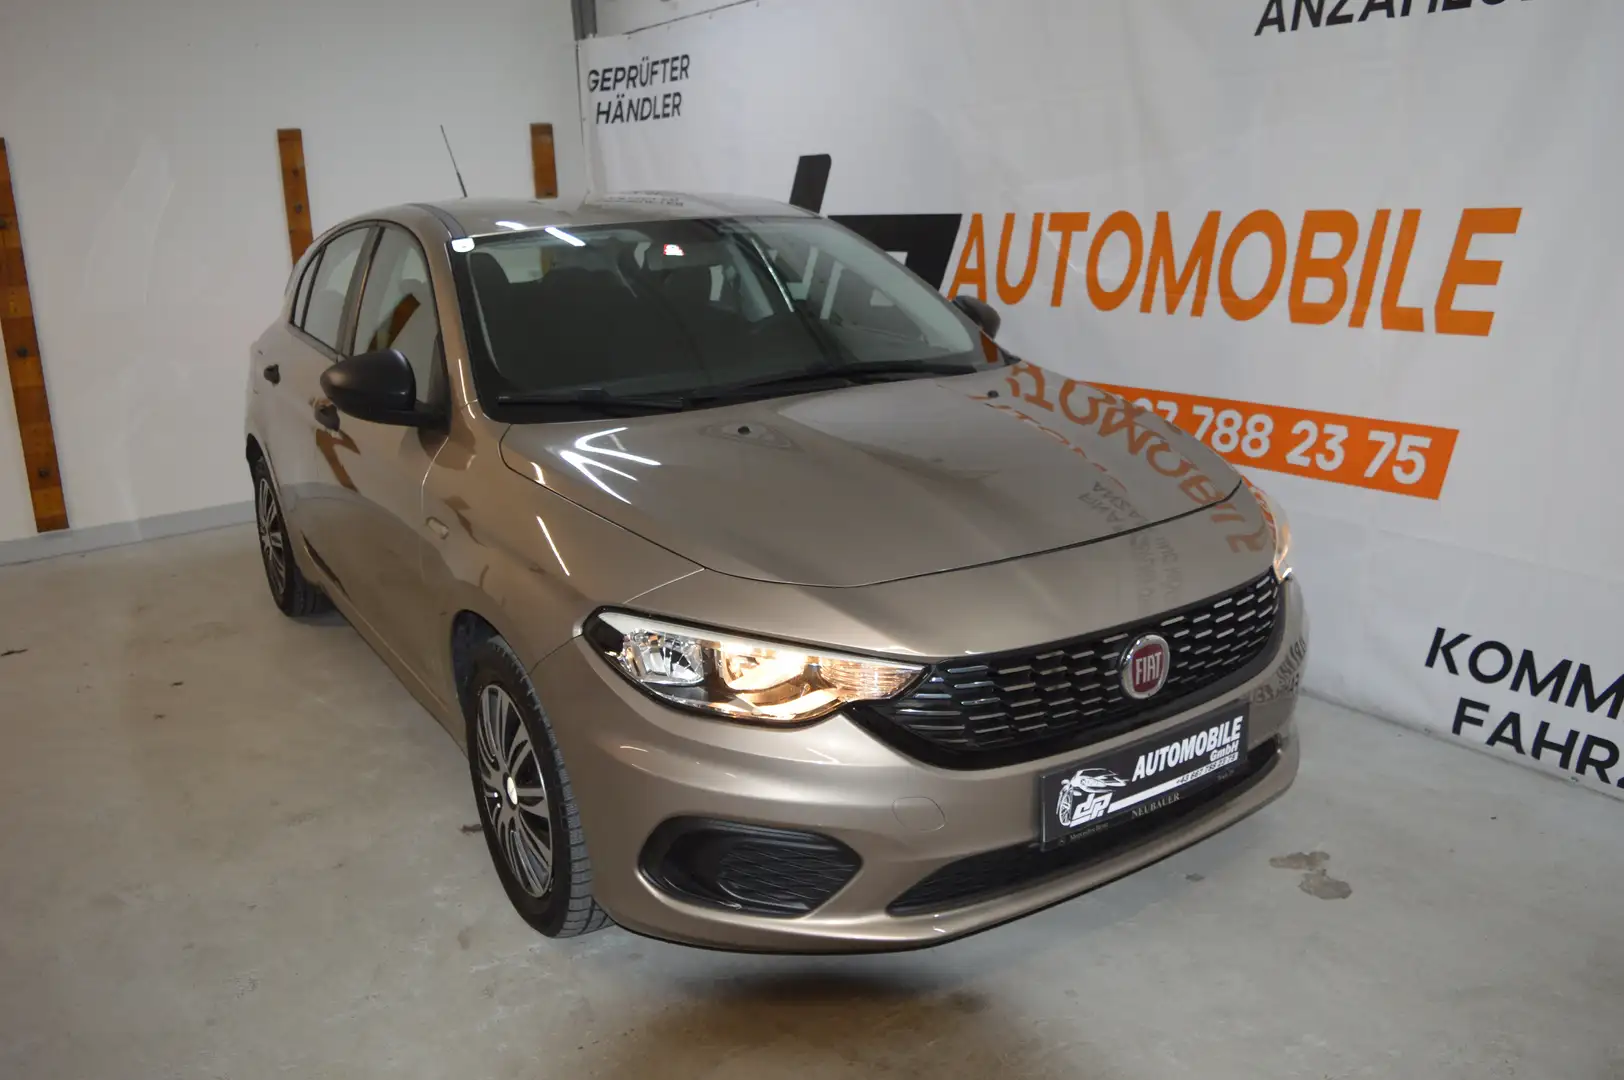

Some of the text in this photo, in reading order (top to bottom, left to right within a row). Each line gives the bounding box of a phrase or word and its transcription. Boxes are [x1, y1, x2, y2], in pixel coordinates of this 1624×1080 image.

[587, 54, 690, 93] GEPRÜFTER
[596, 92, 682, 124] HÄNDLER
[947, 208, 1522, 337] AUTOMOBILE
[1191, 404, 1274, 459] 788
[1285, 420, 1349, 471] 23
[1363, 430, 1432, 485] 75
[1135, 651, 1163, 686] FIAT
[1132, 716, 1243, 782] AUTOMOBILE
[1210, 740, 1239, 762] GmbH
[1452, 697, 1624, 789] FAHR
[1131, 792, 1180, 819] NEUBAUER
